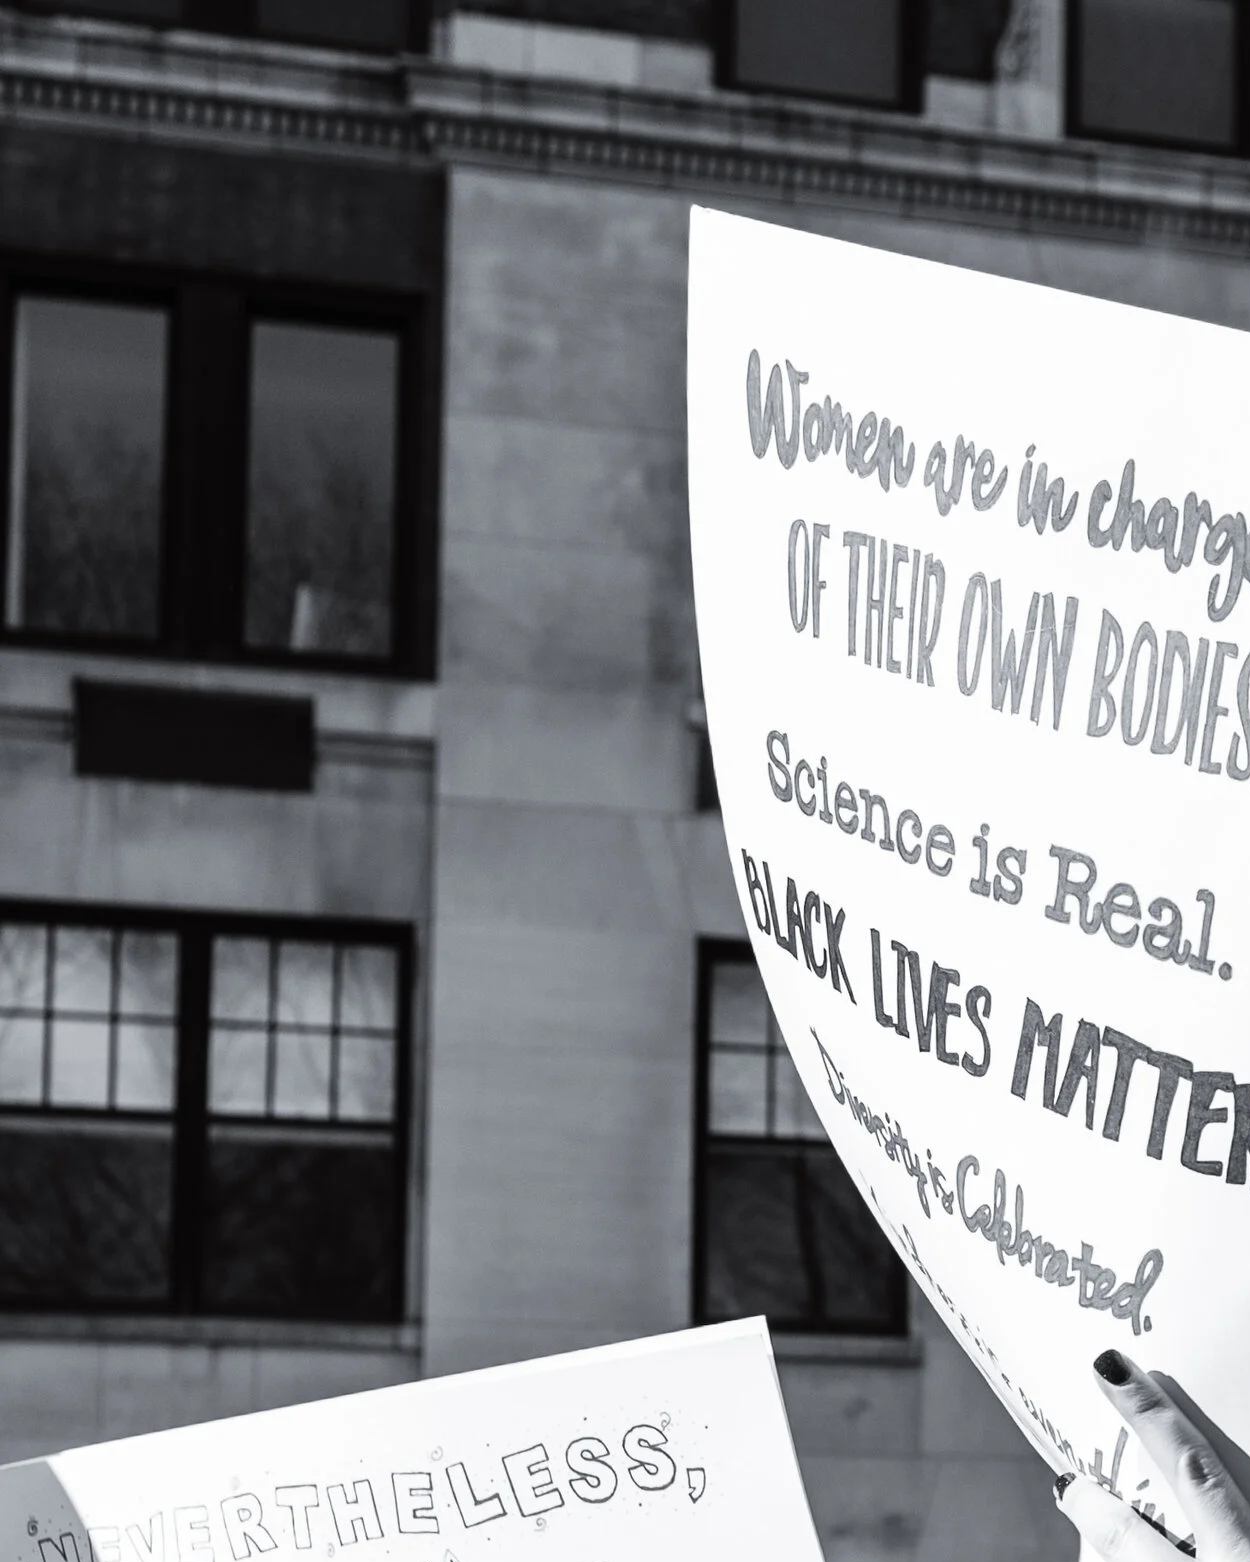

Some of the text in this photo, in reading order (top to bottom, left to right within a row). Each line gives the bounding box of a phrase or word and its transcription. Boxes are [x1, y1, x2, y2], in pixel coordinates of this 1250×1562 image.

[746, 349, 914, 492] Women
[924, 434, 1007, 516] are
[1017, 444, 1079, 535] in
[788, 519, 830, 639] OF
[843, 531, 946, 687] THEIR
[957, 572, 1079, 731] OWN
[766, 730, 1232, 981] Science is Real.
[742, 848, 857, 1005] BLACK
[870, 928, 992, 1078] LIVES
[956, 1154, 1164, 1336] Celebrated.
